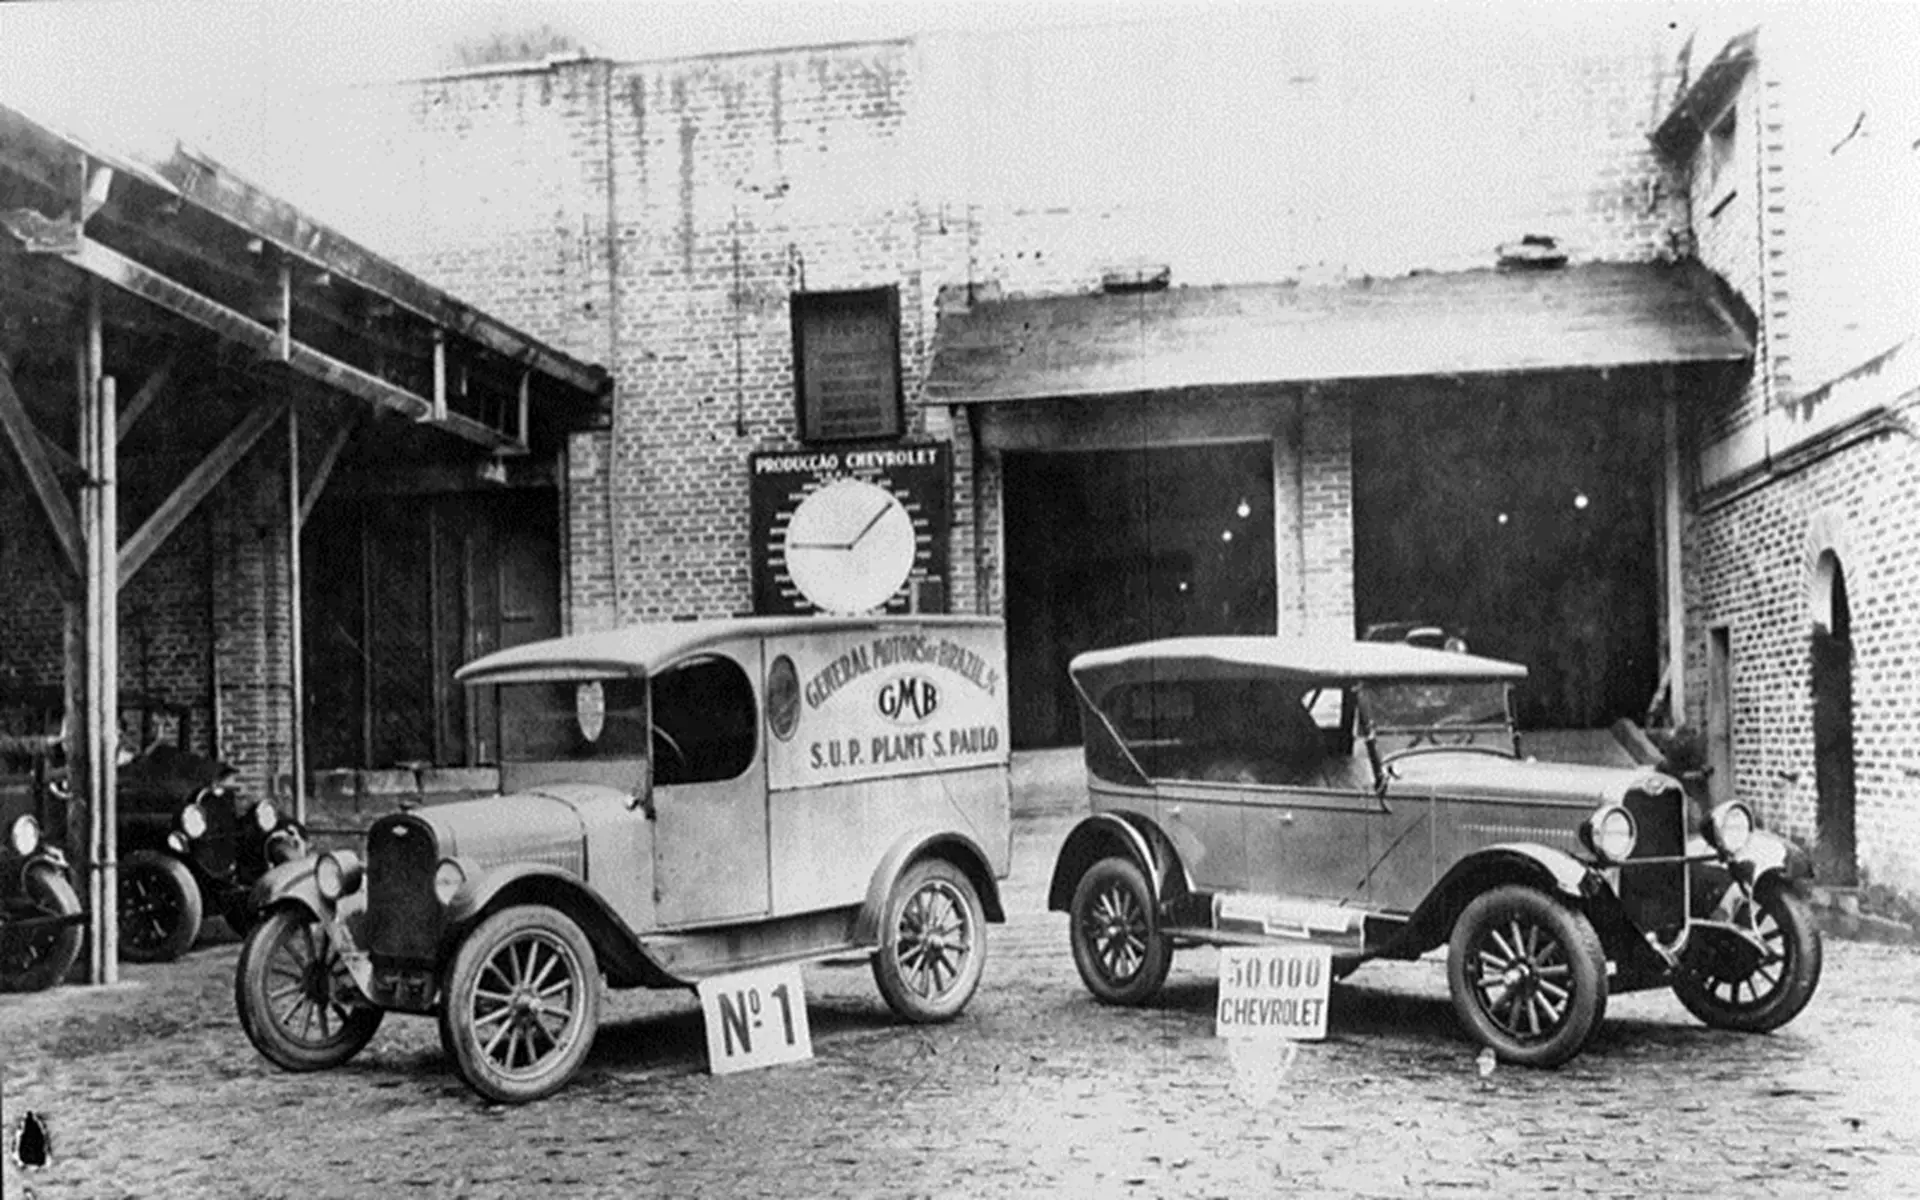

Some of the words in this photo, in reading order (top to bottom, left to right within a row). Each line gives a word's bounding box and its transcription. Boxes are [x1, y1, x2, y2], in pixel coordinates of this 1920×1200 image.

[845, 449, 938, 469] CHEVROLET
[805, 645, 871, 710] GENERAL
[872, 635, 926, 669] MOTORS
[938, 638, 988, 689] BRAZIL
[878, 677, 938, 720] GMB
[872, 732, 927, 764] PLANT
[950, 726, 999, 756] PAULO
[771, 983, 796, 1046] 1
[1220, 998, 1324, 1026] CHEVROLET
